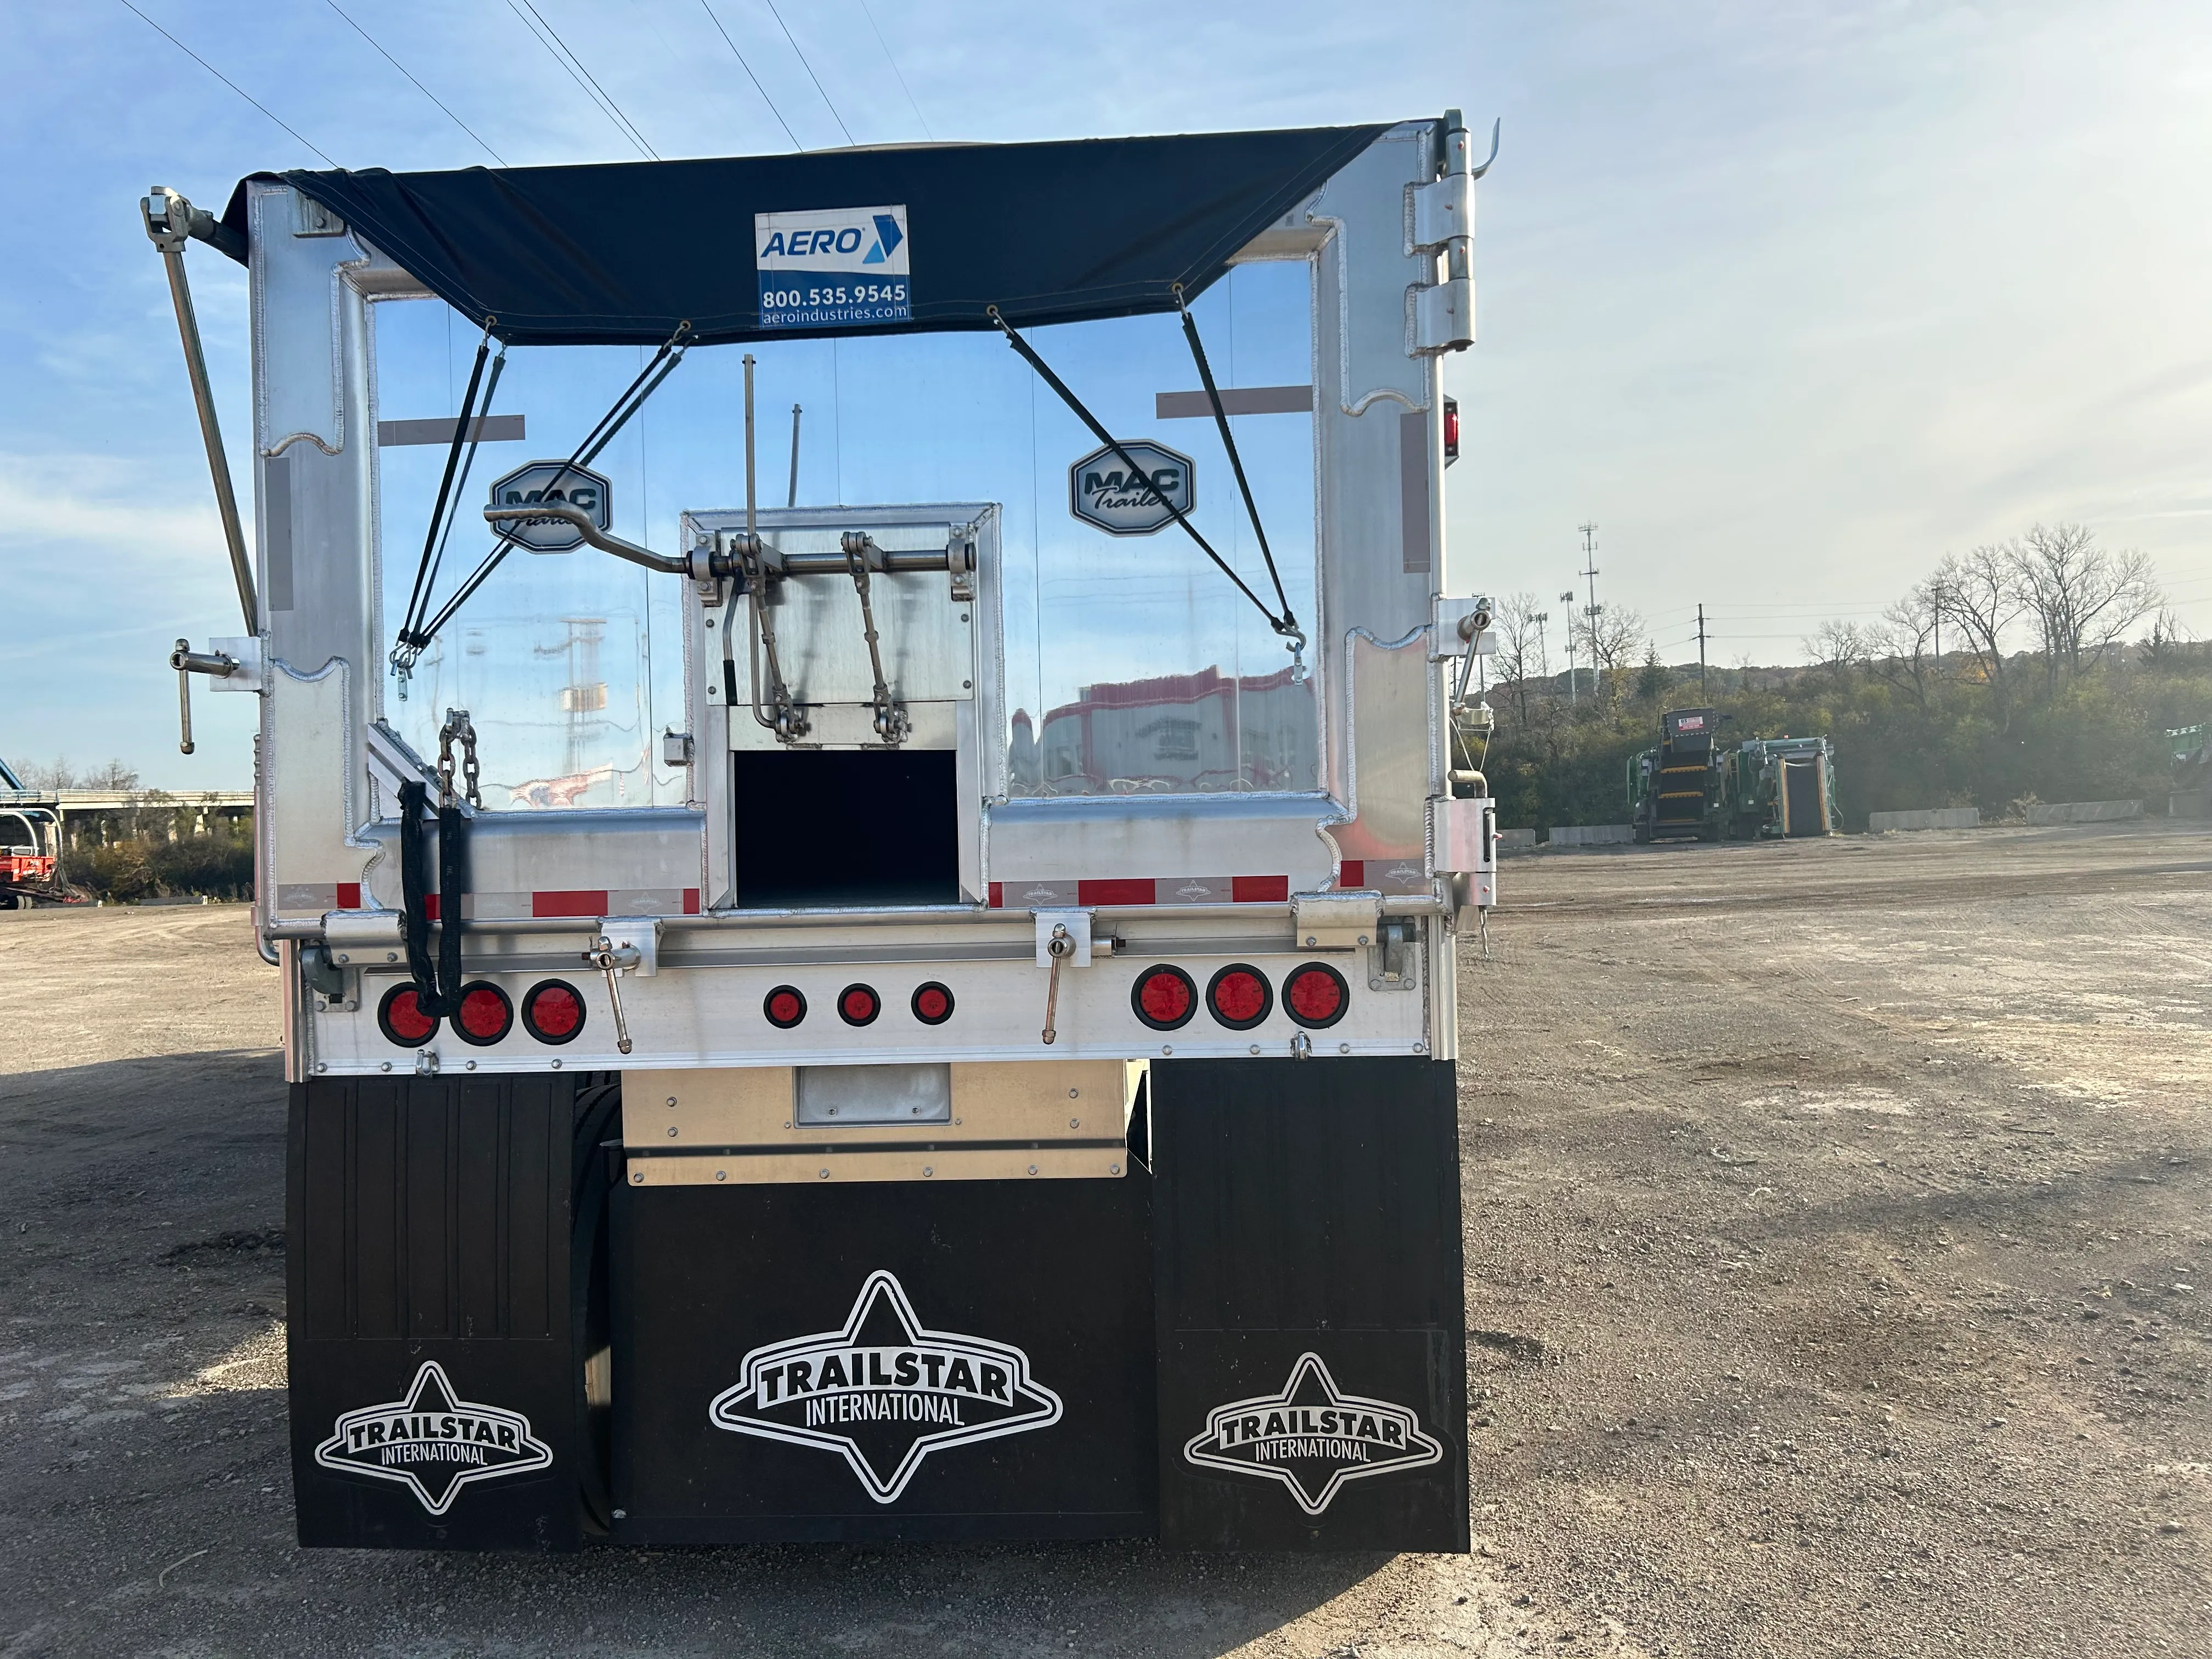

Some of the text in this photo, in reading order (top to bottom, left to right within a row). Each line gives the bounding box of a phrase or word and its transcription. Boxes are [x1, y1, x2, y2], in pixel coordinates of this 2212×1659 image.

[760, 228, 862, 258] AERO
[763, 284, 906, 308] 800.535.9545
[763, 305, 907, 324] aeroindustries.com
[1084, 469, 1180, 495] MAC
[760, 1351, 1011, 1403] TRAILSTAR
[806, 1393, 965, 1426] INTERNATIONAL
[349, 1415, 517, 1450] TRAILSTAR
[1221, 1410, 1403, 1445] TRAILSTAR
[381, 1443, 488, 1466] INTERNATIONAL
[1255, 1438, 1372, 1463] INTERNATIONAL
